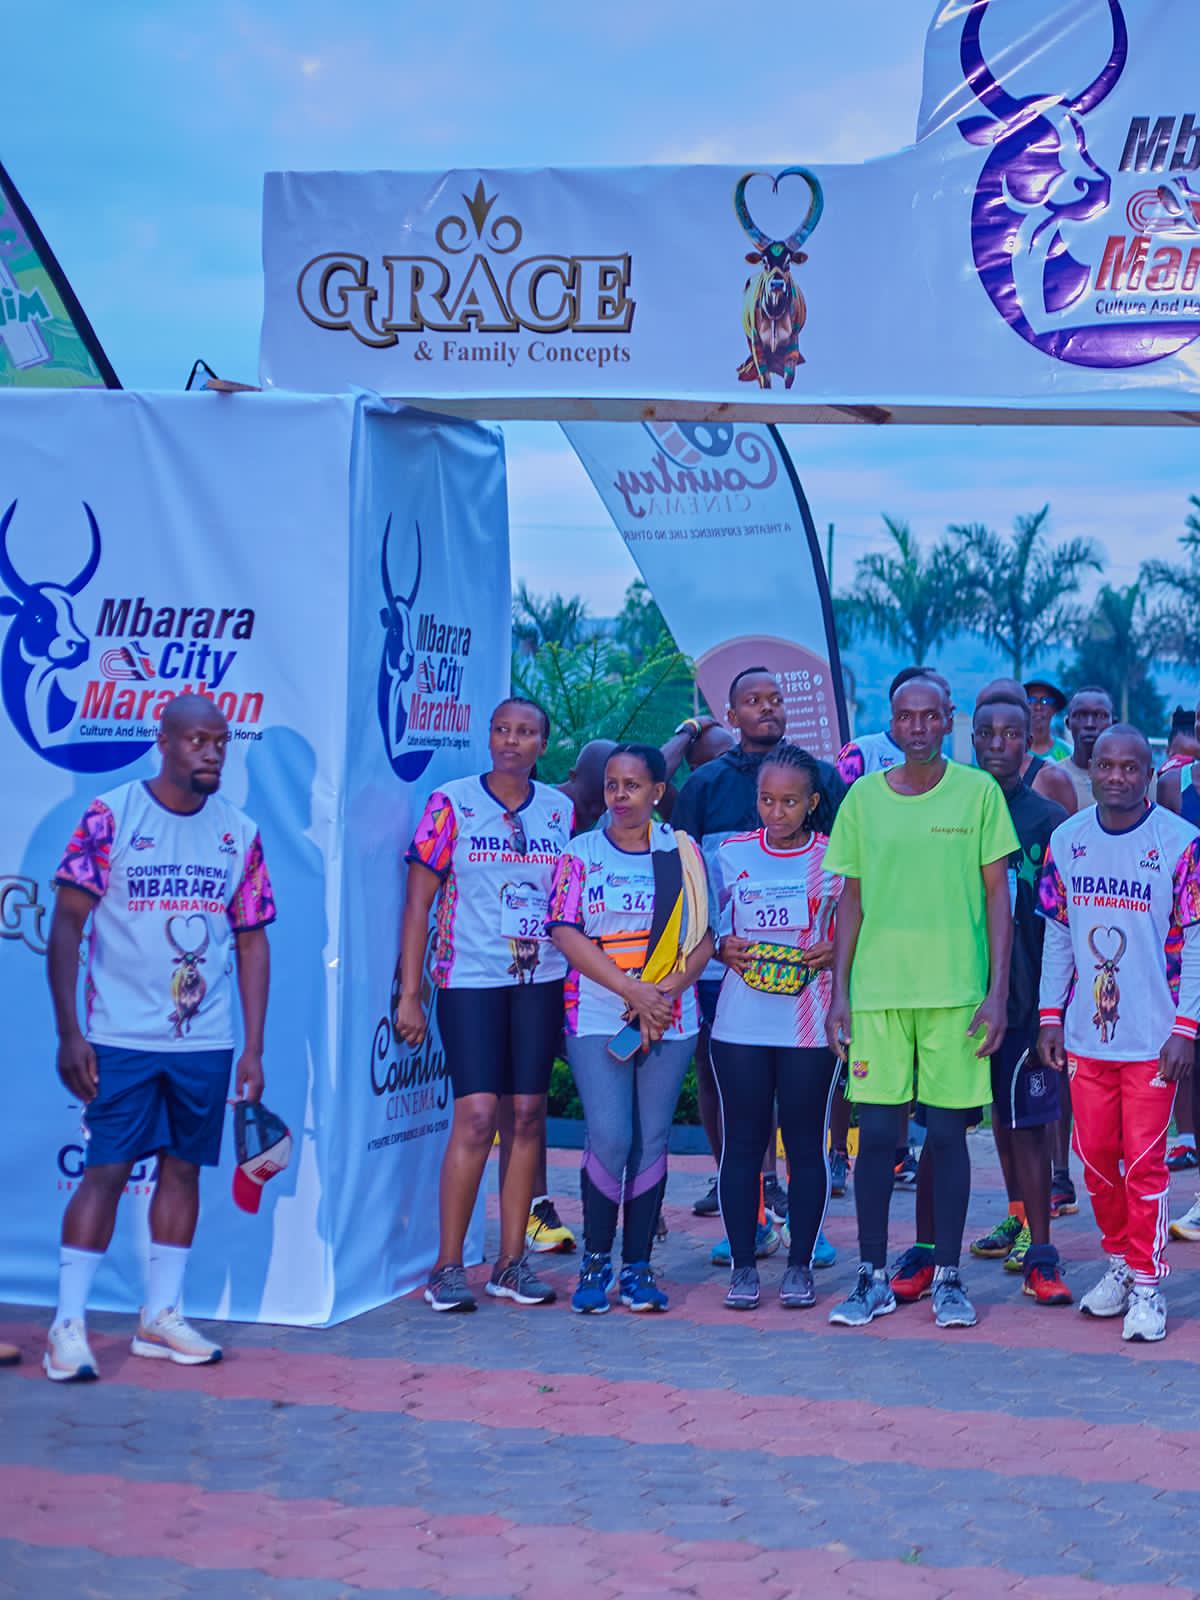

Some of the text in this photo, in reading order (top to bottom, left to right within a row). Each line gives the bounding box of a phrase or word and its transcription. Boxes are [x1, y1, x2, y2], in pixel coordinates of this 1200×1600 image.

[297, 252, 636, 348] GRACE
[1095, 298, 1146, 315] Culture
[1151, 299, 1178, 315] And
[414, 341, 632, 368] & Family Concepts
[95, 597, 256, 640] Mbarara
[416, 613, 472, 656] Mbarara
[158, 641, 238, 689] City
[437, 656, 464, 702] City
[79, 680, 265, 724] Maraon
[407, 693, 472, 733] Marathon
[80, 725, 162, 738] Culture And Herit
[234, 729, 263, 741] Horns
[468, 852, 559, 865] CITY MARATHO
[470, 836, 562, 856] MBAAR
[126, 864, 182, 878] COUNTRY
[128, 899, 155, 912] CITY
[755, 908, 789, 928] 328
[370, 1016, 451, 1111] Country
[386, 1087, 436, 1120] CINEMA
